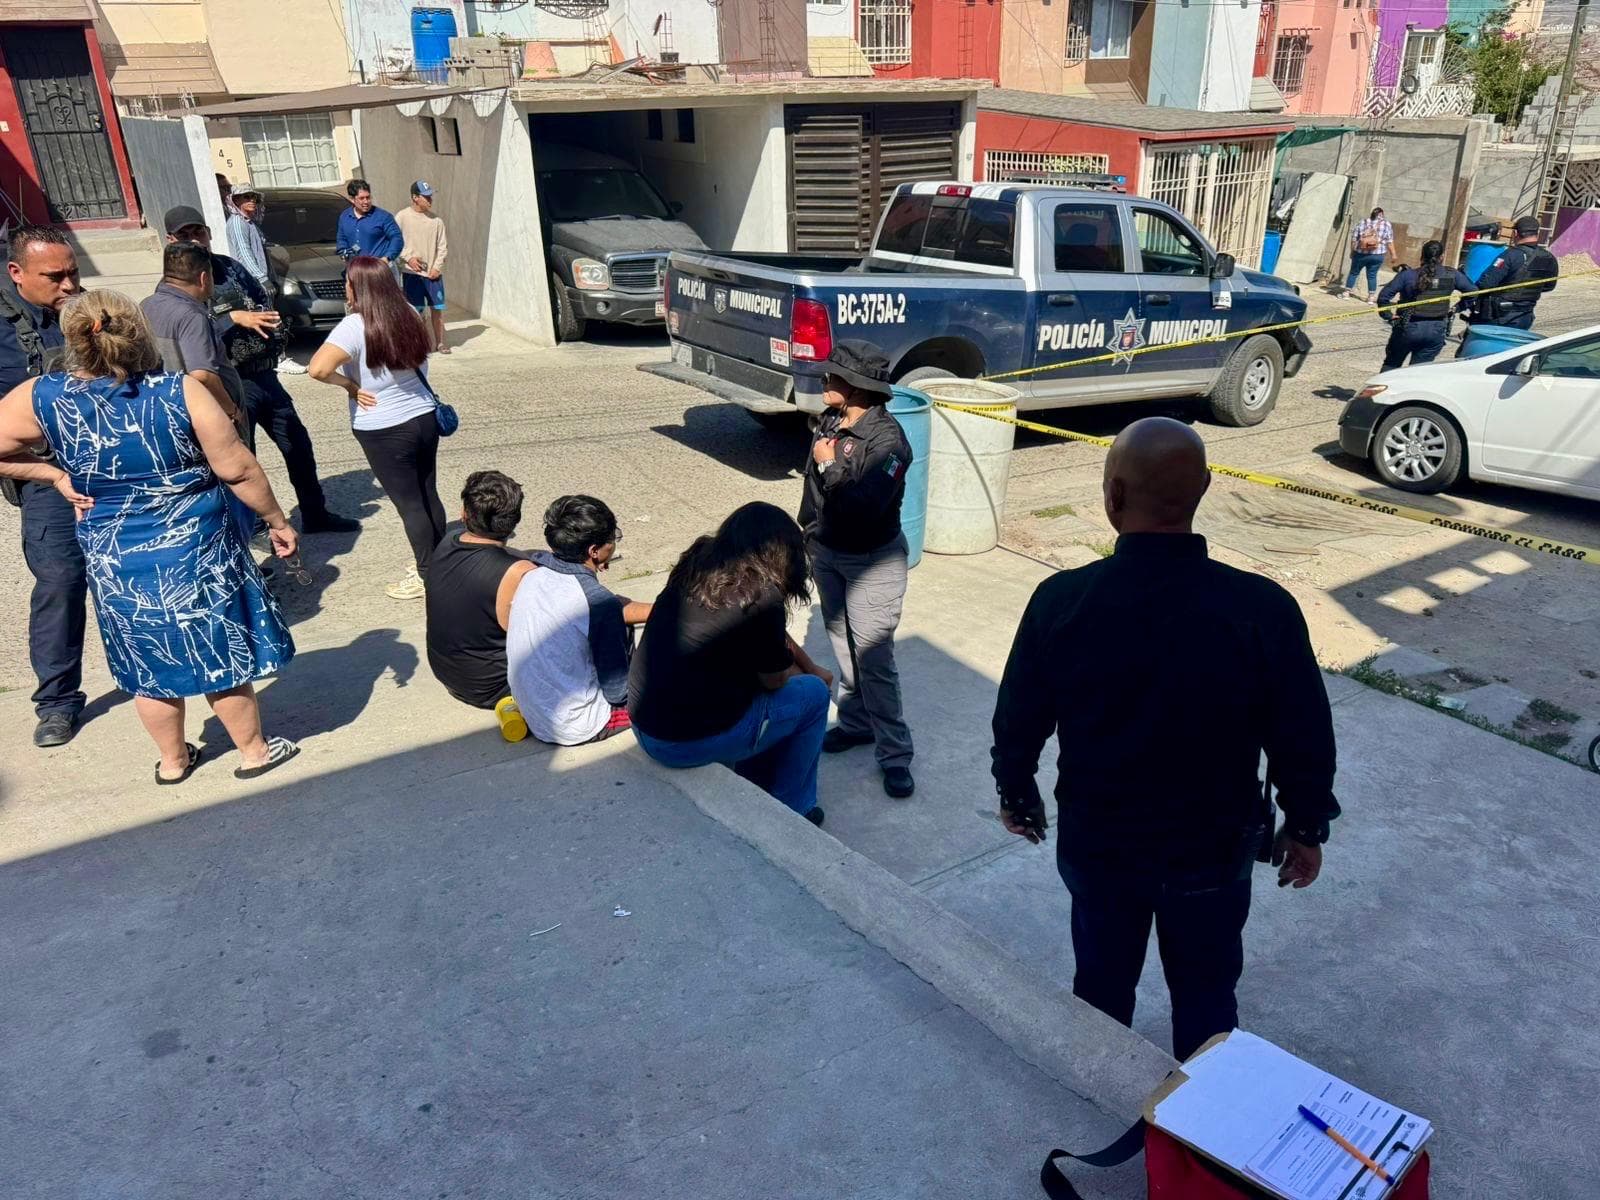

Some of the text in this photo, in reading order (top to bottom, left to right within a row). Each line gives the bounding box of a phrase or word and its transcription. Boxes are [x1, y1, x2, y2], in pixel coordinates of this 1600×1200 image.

[677, 277, 783, 319] POLICÍA MUNICIPAL
[837, 293, 906, 325] BC-375A-2
[1037, 319, 1228, 351] POLICÍA MUNICIPAL
